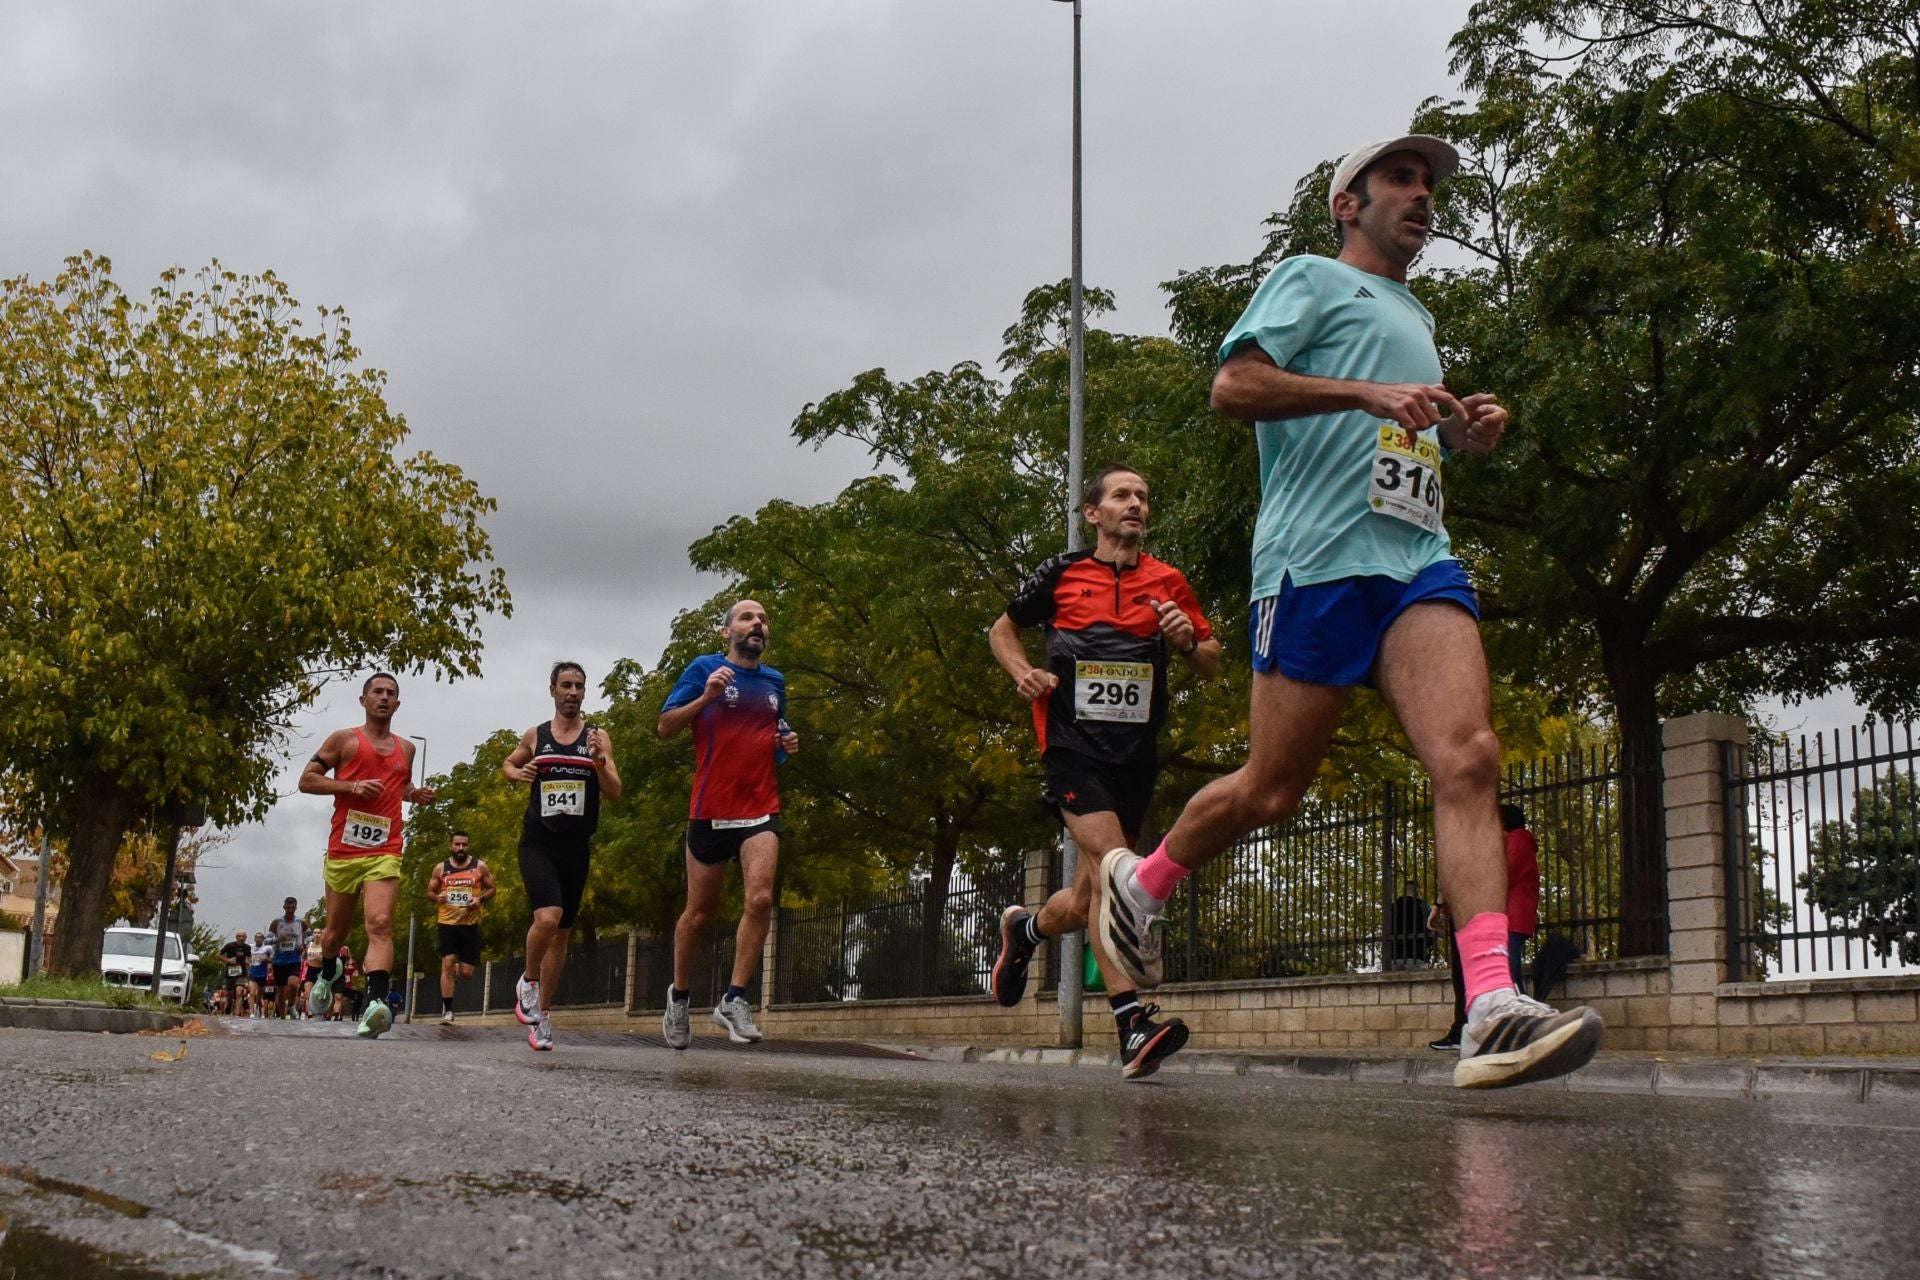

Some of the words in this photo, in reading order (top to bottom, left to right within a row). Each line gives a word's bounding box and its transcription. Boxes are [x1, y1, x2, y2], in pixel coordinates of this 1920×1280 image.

[1394, 434, 1410, 450] 38
[1087, 664, 1100, 674] 38
[1087, 682, 1139, 706] 296
[548, 793, 576, 806] 841
[352, 824, 383, 842] 192
[450, 893, 468, 901] 256
